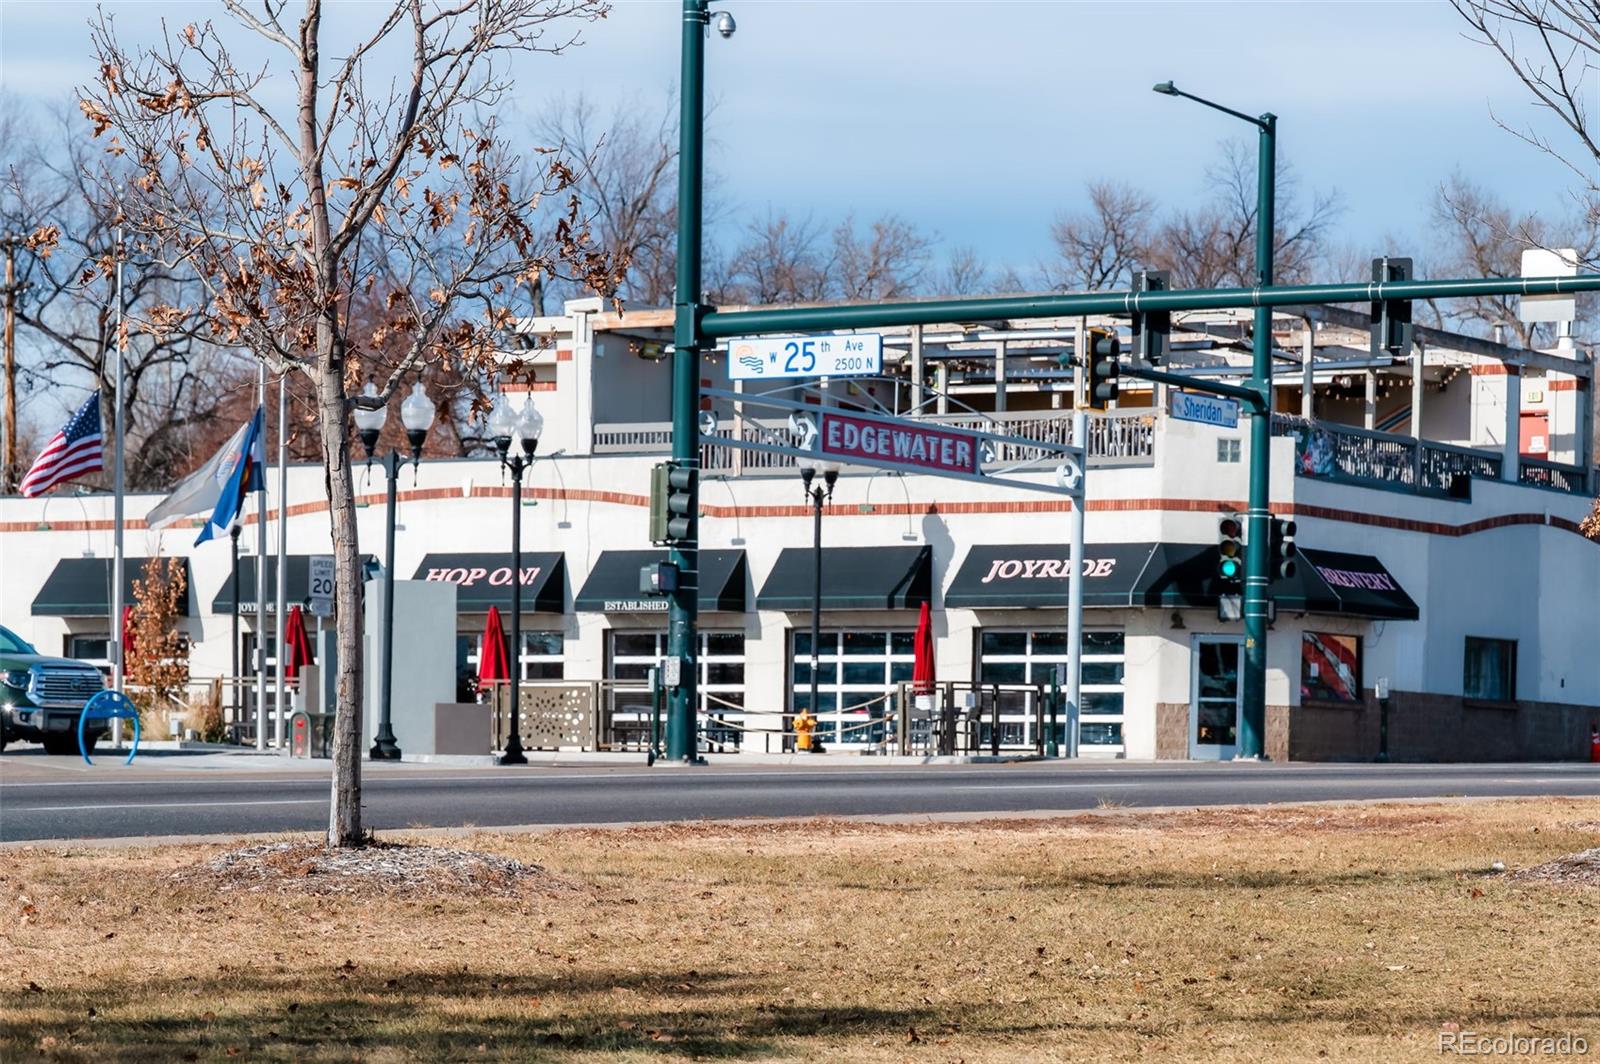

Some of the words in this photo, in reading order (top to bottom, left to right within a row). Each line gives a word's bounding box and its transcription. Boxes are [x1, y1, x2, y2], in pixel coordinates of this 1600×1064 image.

[769, 351, 778, 363] W
[845, 339, 863, 352] Ave
[835, 357, 862, 371] 2500
[866, 357, 873, 369] N
[1183, 397, 1222, 422] Sheridan
[827, 420, 971, 468] EDGEWATER
[313, 578, 332, 594] 20
[424, 567, 487, 586] HOP
[488, 567, 541, 586] ON!
[1316, 566, 1396, 591] BREWERY
[238, 601, 275, 613] JOYRE
[604, 600, 669, 611] ESTABLISHED
